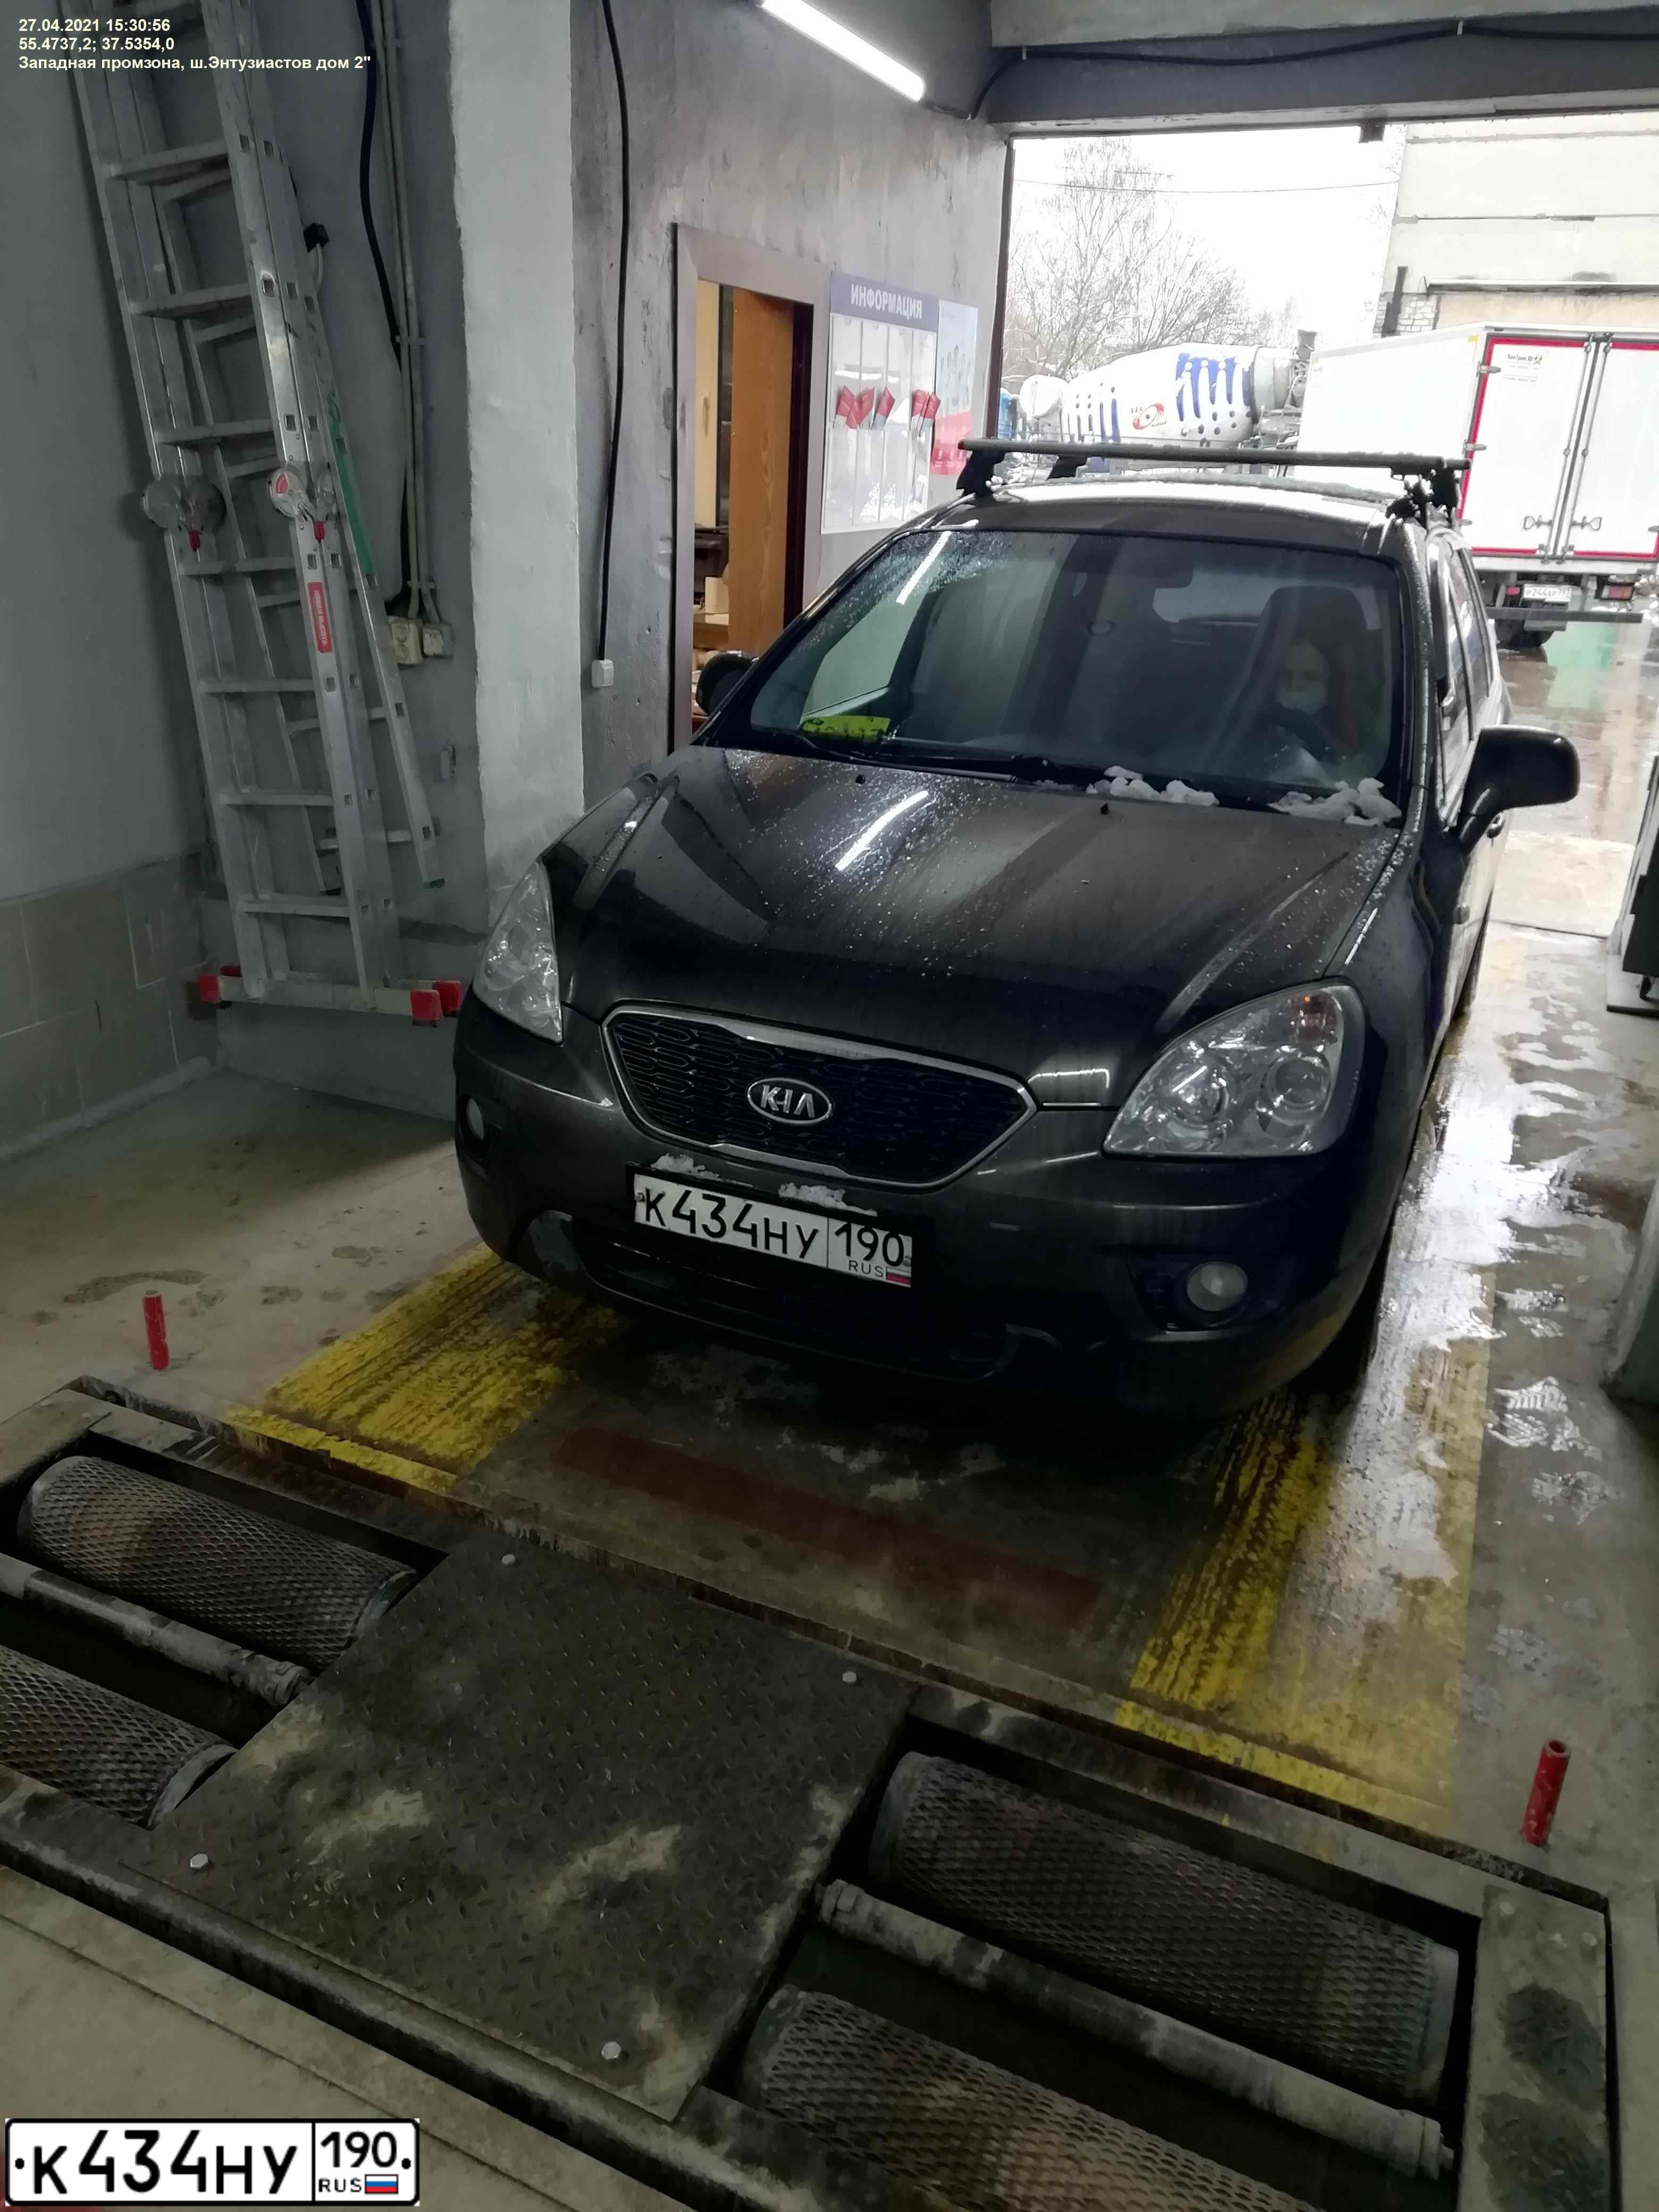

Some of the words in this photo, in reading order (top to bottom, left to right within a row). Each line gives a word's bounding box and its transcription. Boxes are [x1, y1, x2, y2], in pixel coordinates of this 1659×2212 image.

[851, 283, 923, 321] ИНФОРМАЦИЯ
[760, 1084, 815, 1118] KIA
[645, 1188, 819, 1259] К434НУ
[834, 1225, 904, 1267] 190
[848, 1259, 884, 1278] RUS
